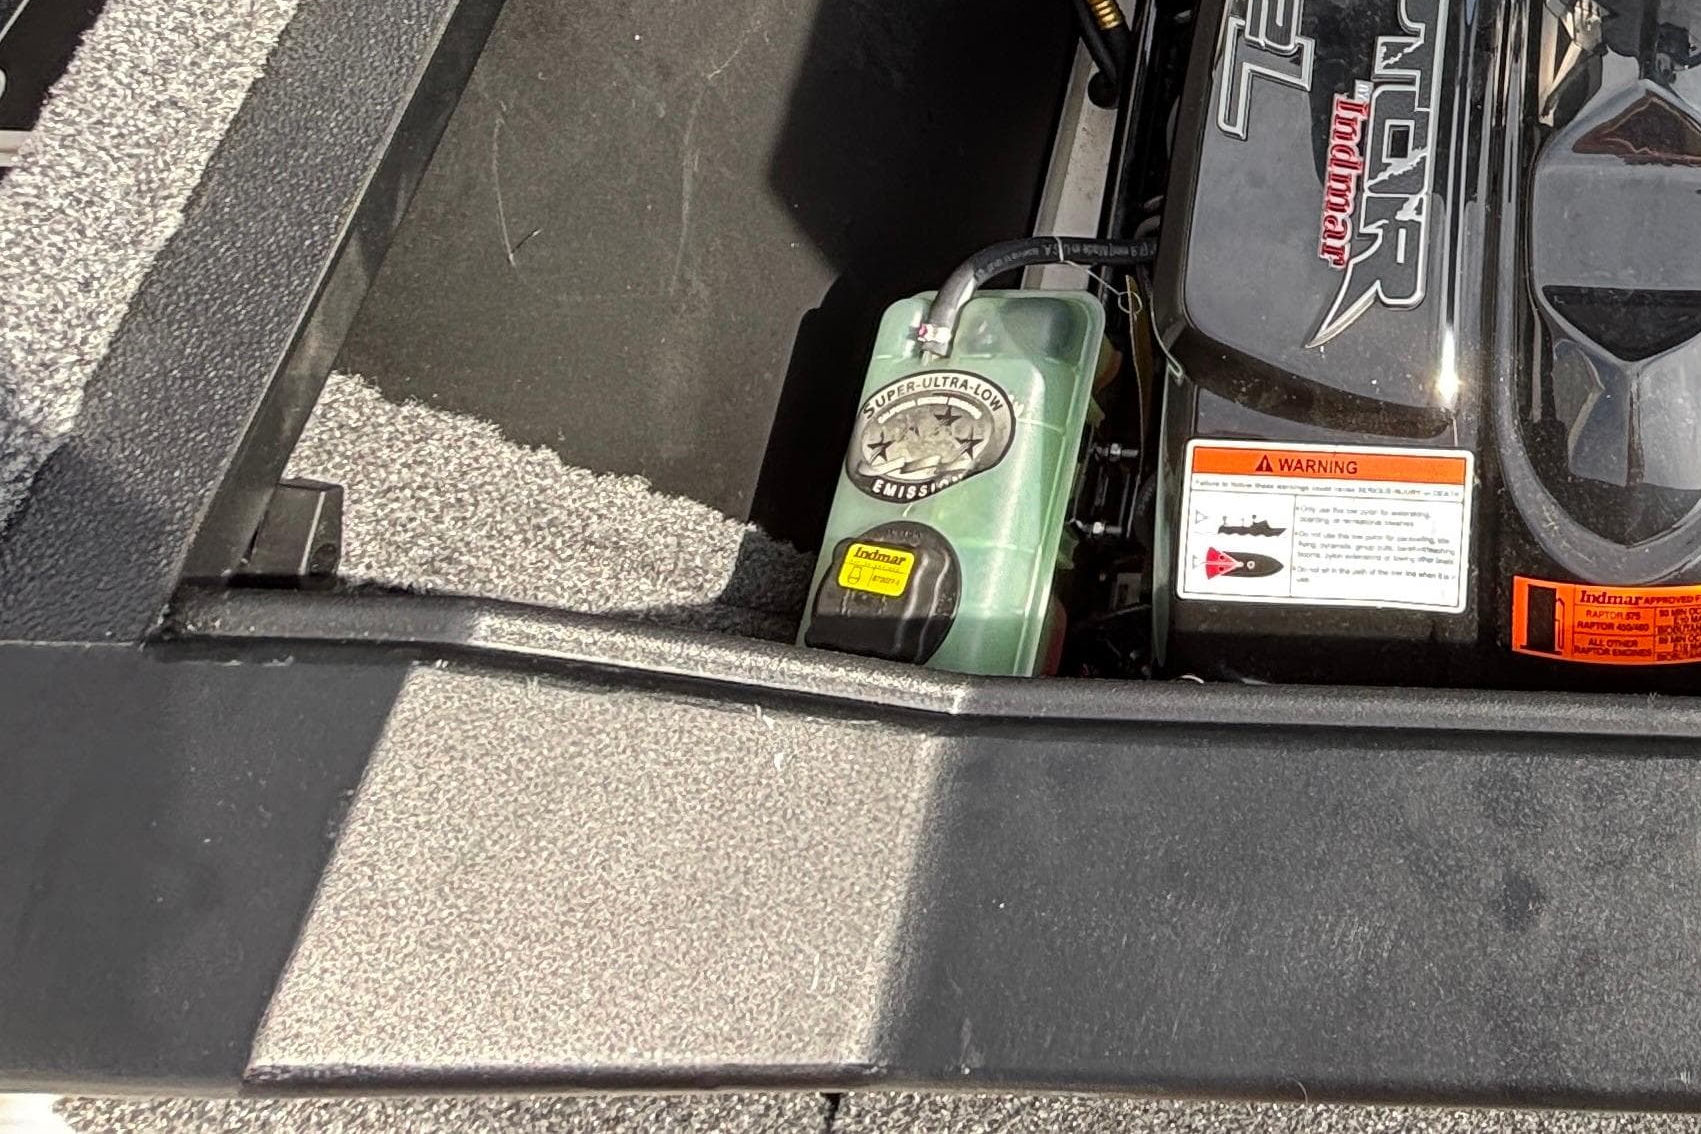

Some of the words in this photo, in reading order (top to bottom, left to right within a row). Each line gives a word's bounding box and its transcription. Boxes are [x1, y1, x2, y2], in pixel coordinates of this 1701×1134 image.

[1320, 97, 1371, 268] Indmar
[1278, 458, 1359, 475] WARNING
[871, 471, 965, 500] EMISSI
[853, 546, 906, 566] Indmar
[1580, 589, 1643, 606] Indmar
[1643, 594, 1694, 605] APPROVED
[1586, 609, 1624, 621] RAPTOR
[1577, 621, 1615, 631] RAPTOR
[1574, 645, 1611, 656] RAPTOR
[1588, 637, 1605, 647] ALL
[1606, 639, 1638, 649] OTHER
